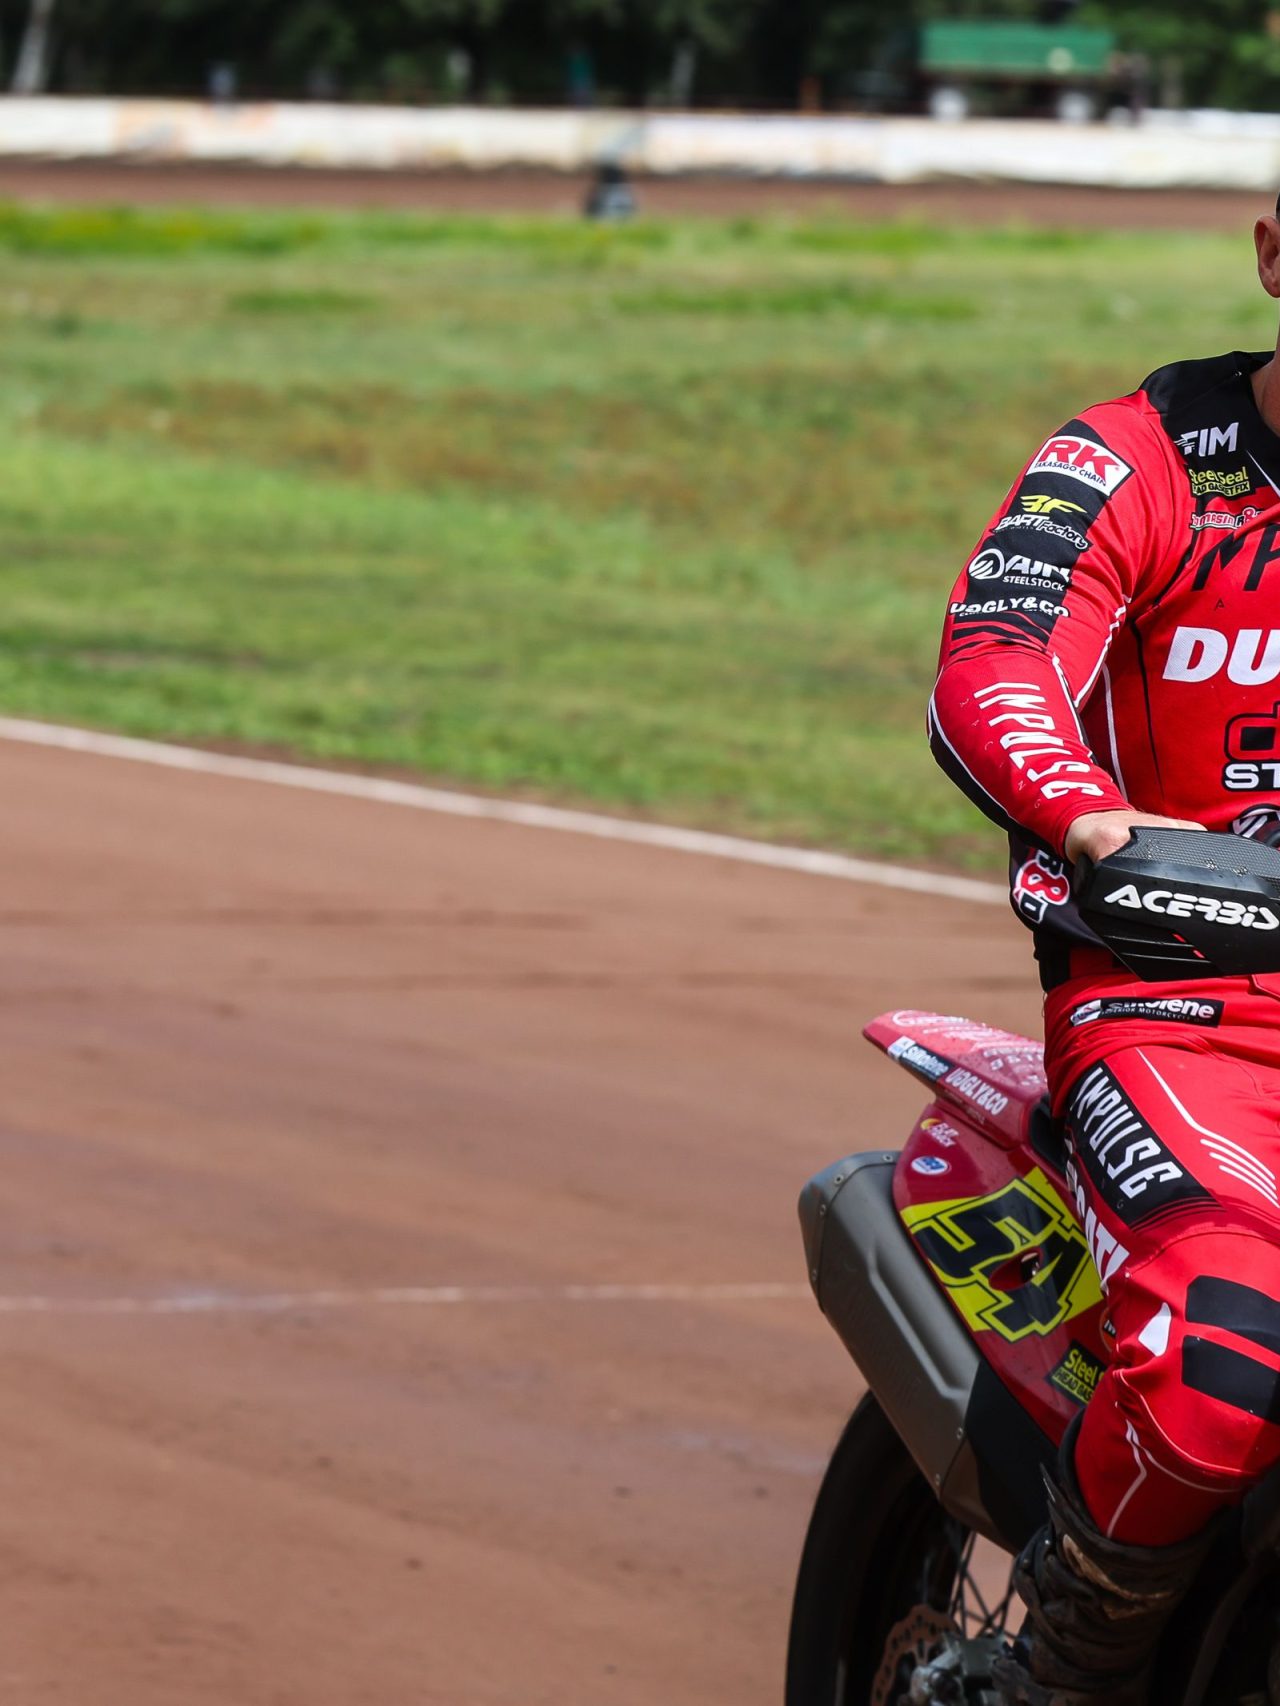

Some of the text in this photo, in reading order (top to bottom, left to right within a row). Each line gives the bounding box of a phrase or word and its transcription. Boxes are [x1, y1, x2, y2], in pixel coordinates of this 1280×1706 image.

[1173, 422, 1240, 457] FIM
[1039, 439, 1121, 482] RK
[1078, 469, 1107, 487] CHAIN
[1002, 575, 1065, 592] STEELSTOCK
[1103, 883, 1280, 931] ACERBIS
[910, 1183, 1089, 1337] 54
[1064, 1348, 1099, 1387] Steel
